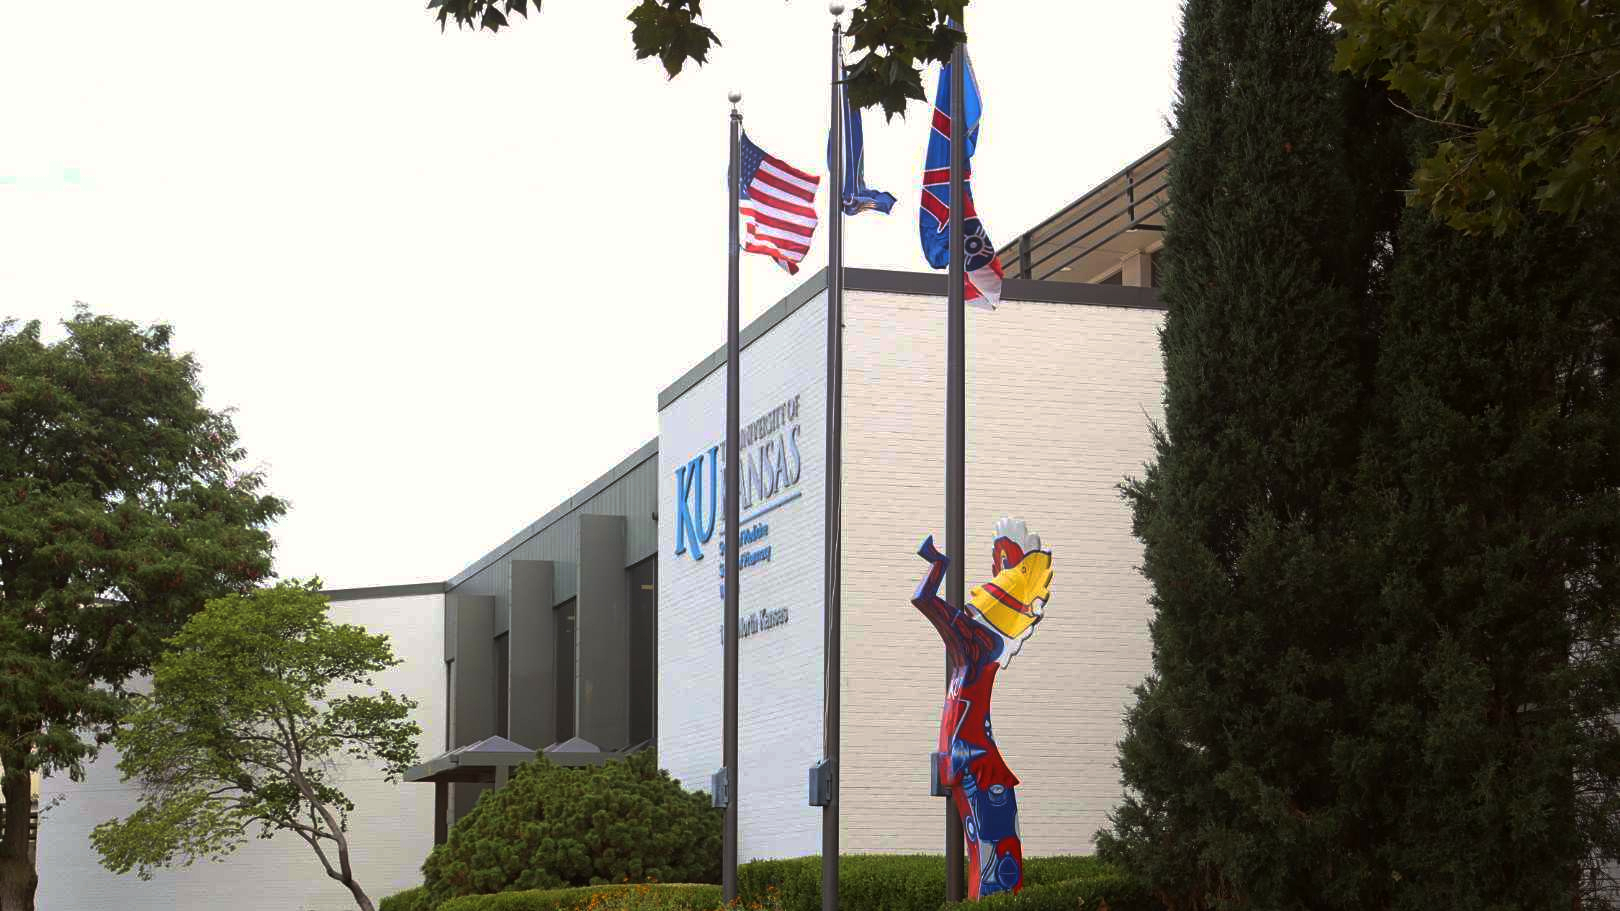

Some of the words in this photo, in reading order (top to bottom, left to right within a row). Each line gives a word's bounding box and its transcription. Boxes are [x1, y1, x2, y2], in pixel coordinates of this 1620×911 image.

[787, 394, 801, 421] OF
[674, 446, 719, 561] KU
[760, 608, 789, 632] Kansas
